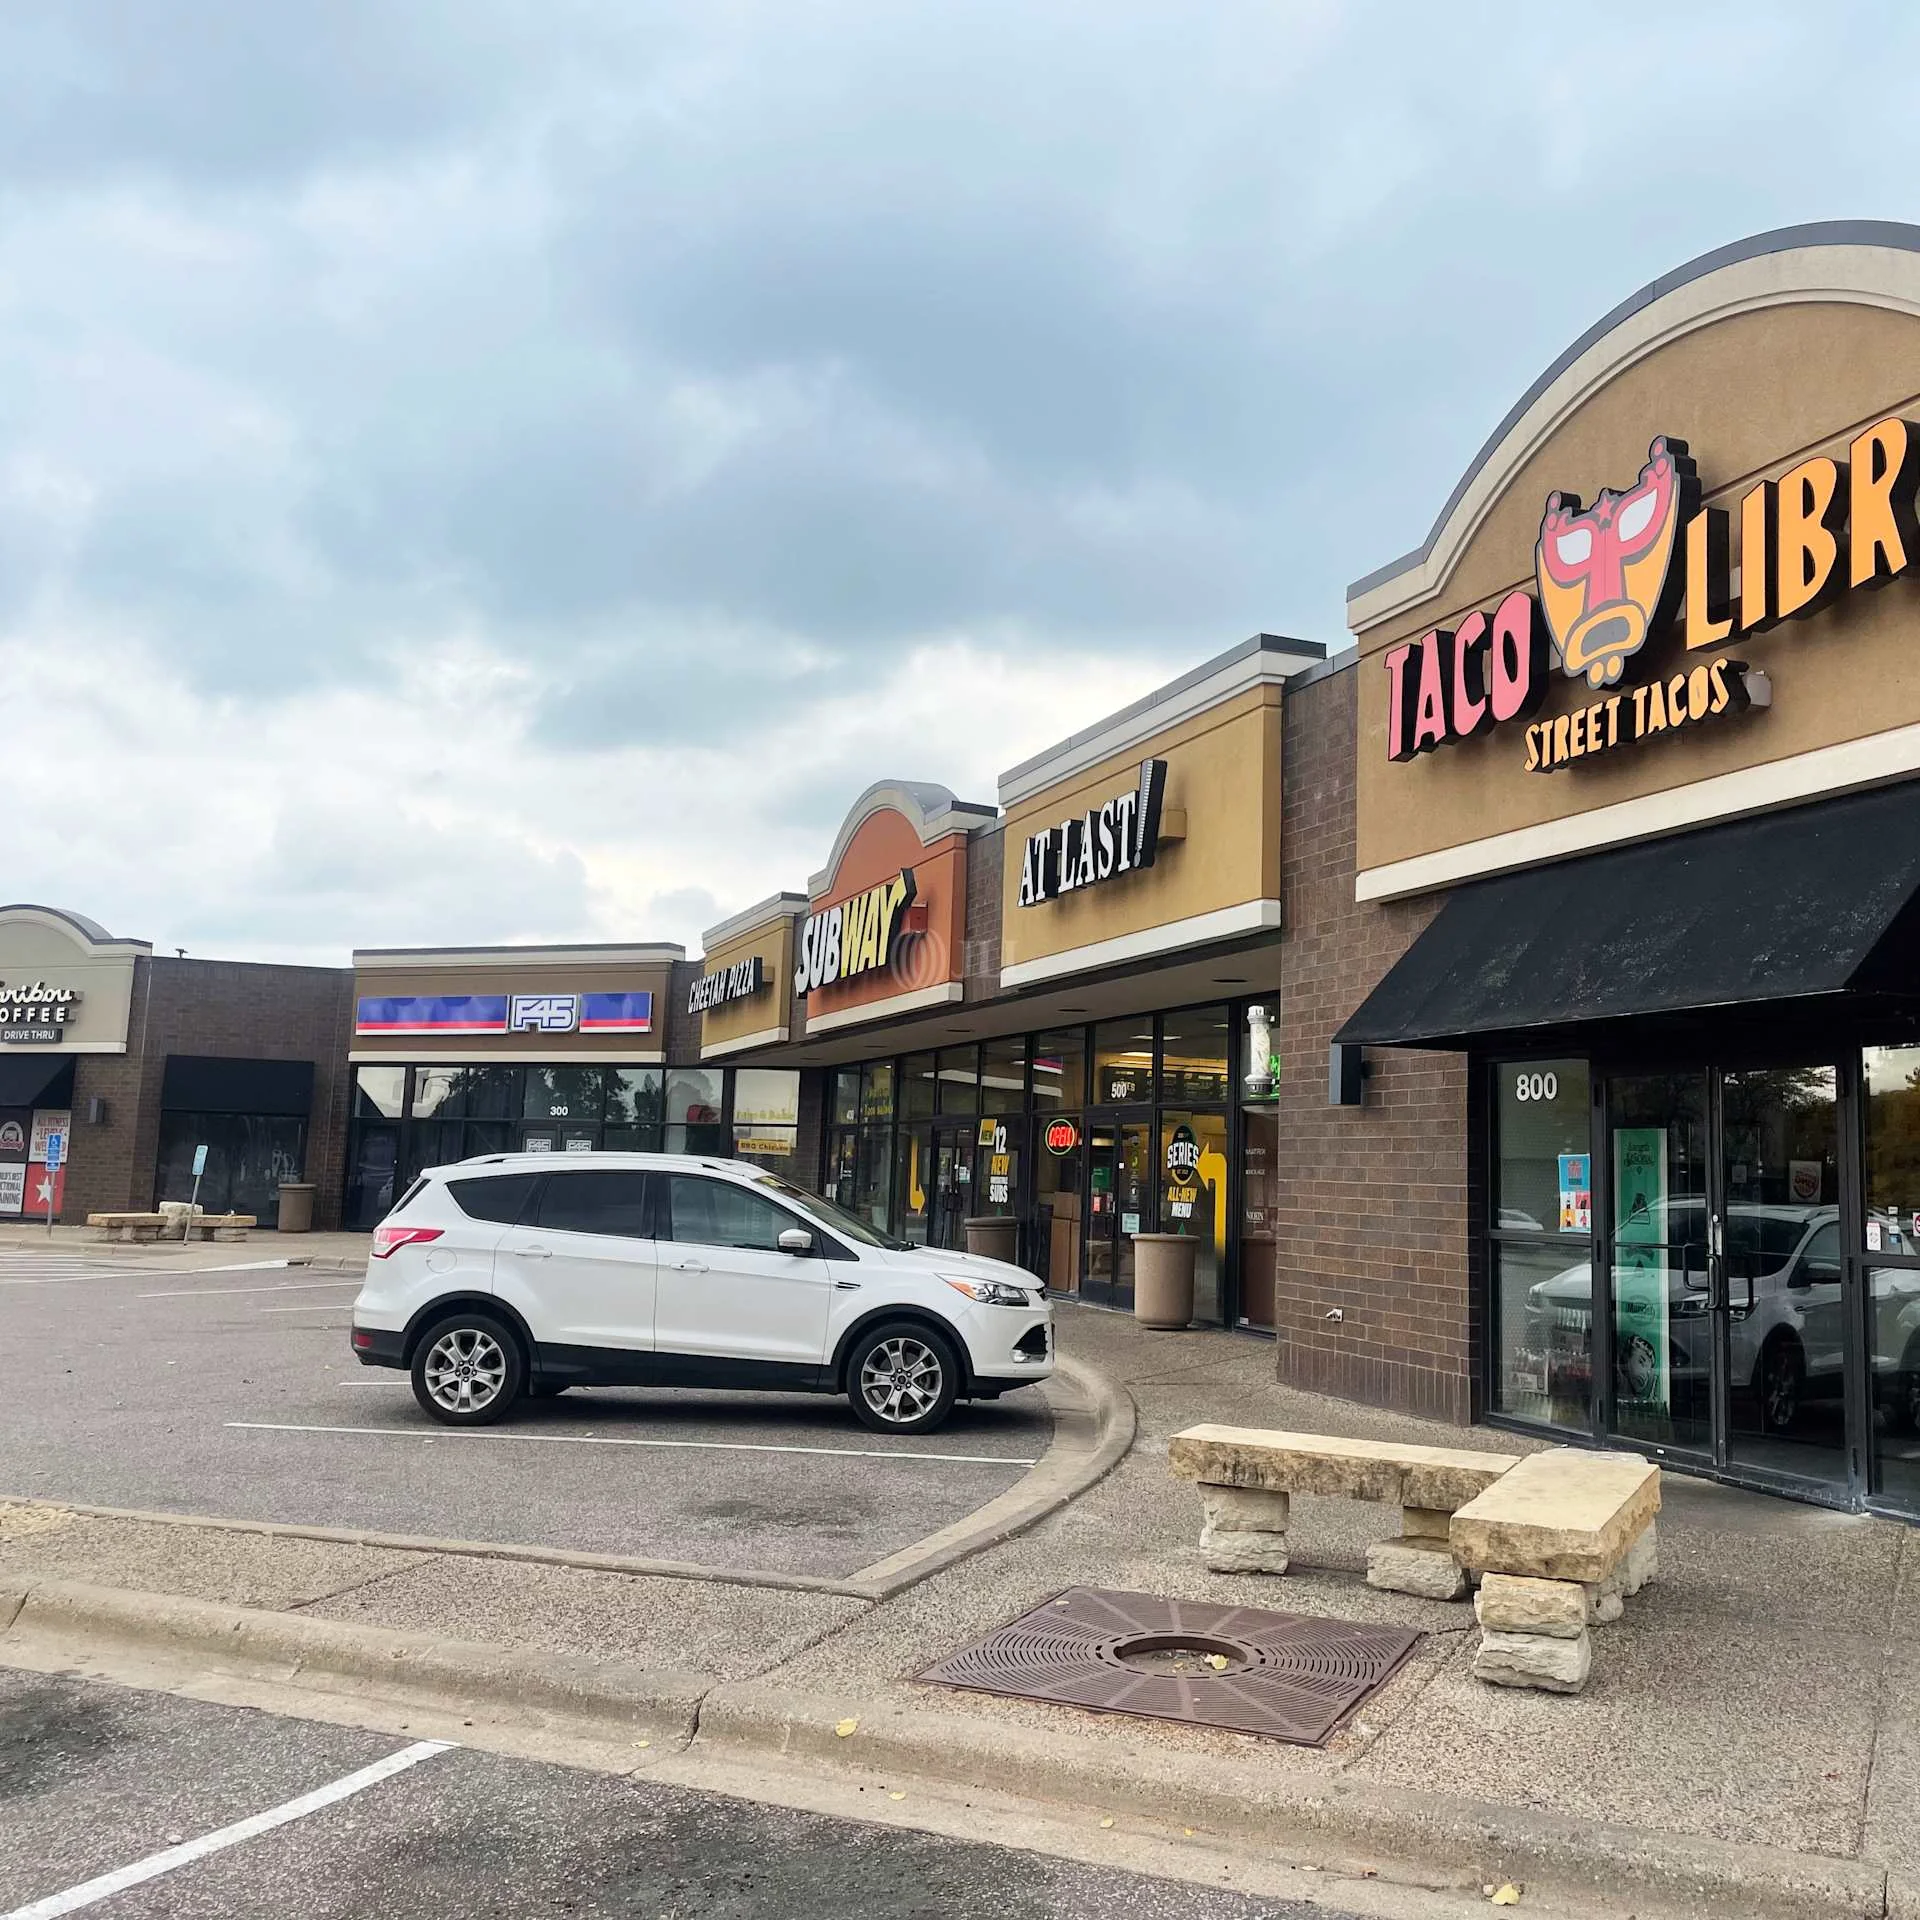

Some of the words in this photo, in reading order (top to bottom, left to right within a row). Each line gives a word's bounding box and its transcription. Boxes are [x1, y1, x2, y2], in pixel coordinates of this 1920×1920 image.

[1385, 591, 1532, 761] TACO
[1524, 696, 1622, 772] STREET
[1632, 658, 1730, 739] TACOS
[1018, 831, 1051, 907] AT
[795, 868, 909, 994] SUBWAY
[688, 968, 728, 1014] CHEETAH
[726, 956, 755, 1000] PIZZA
[0, 1006, 66, 1023] OFFEE
[511, 994, 577, 1032] F45
[4, 1030, 30, 1040] DRIVE
[31, 1029, 55, 1040] THRU
[1111, 1082, 1128, 1098] 500
[1516, 1072, 1558, 1101] 800
[550, 1106, 569, 1116] 300
[995, 1126, 1007, 1154] 12
[1049, 1126, 1072, 1147] OPEN
[991, 1155, 1010, 1175] NEW
[1167, 1141, 1199, 1169] SERIES
[989, 1184, 1009, 1203] SUBS
[1167, 1186, 1198, 1203] ALL-NEW
[1171, 1202, 1193, 1218] MENU
